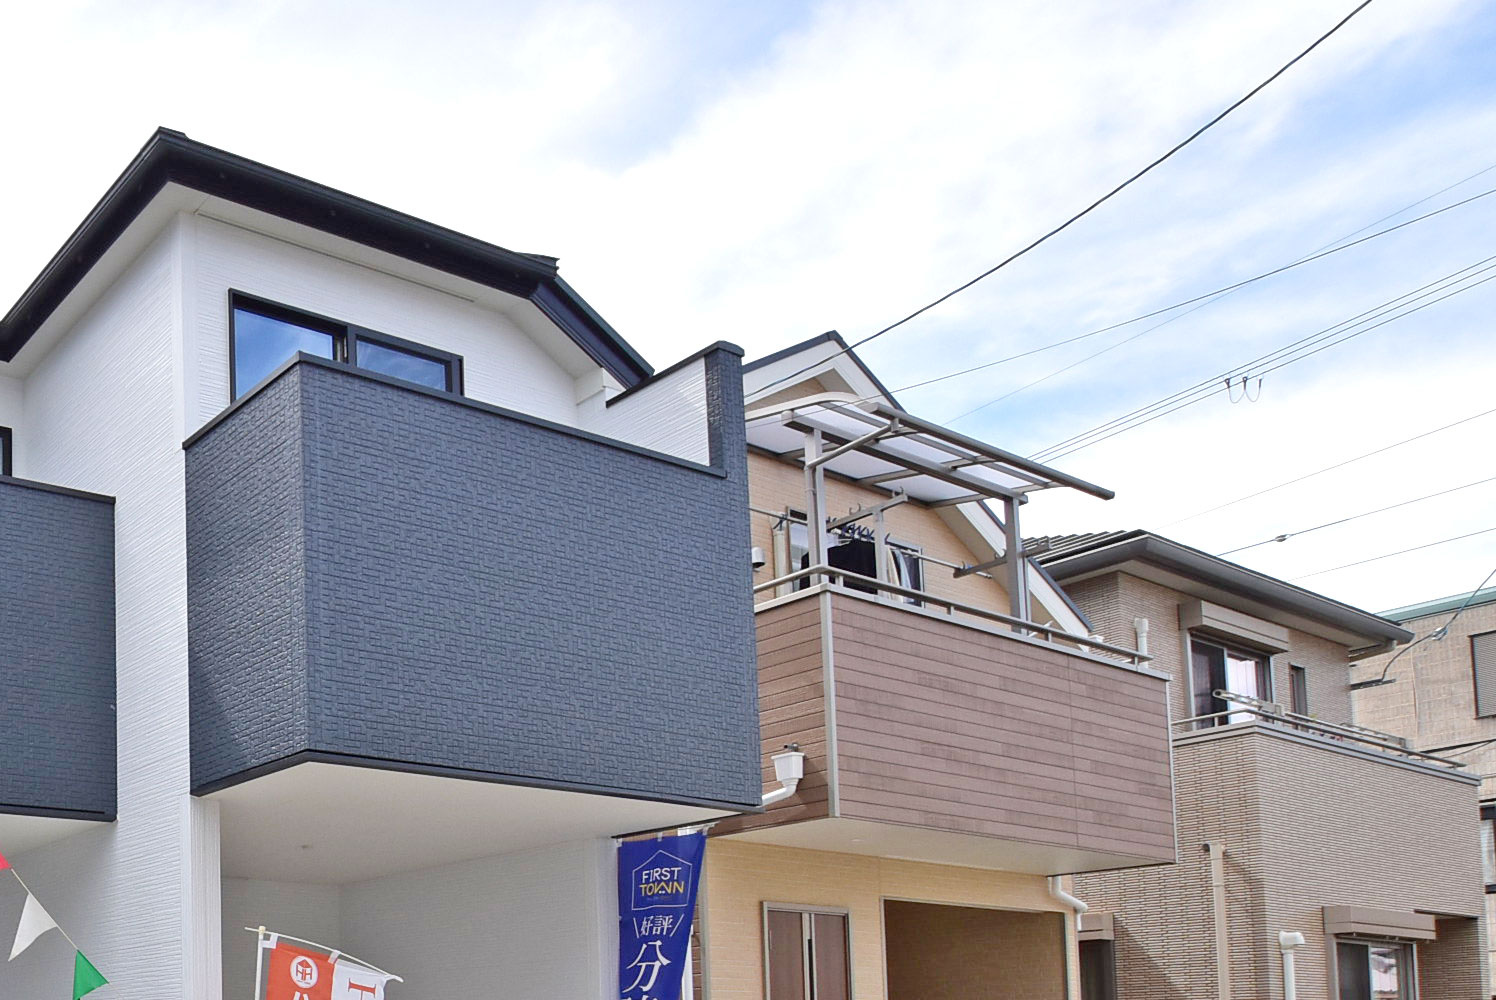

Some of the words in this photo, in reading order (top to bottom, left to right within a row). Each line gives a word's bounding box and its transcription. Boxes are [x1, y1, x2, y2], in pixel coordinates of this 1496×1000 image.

[642, 867, 682, 883] FIRST
[639, 881, 684, 896] TOWN
[640, 915, 673, 936] 好評
